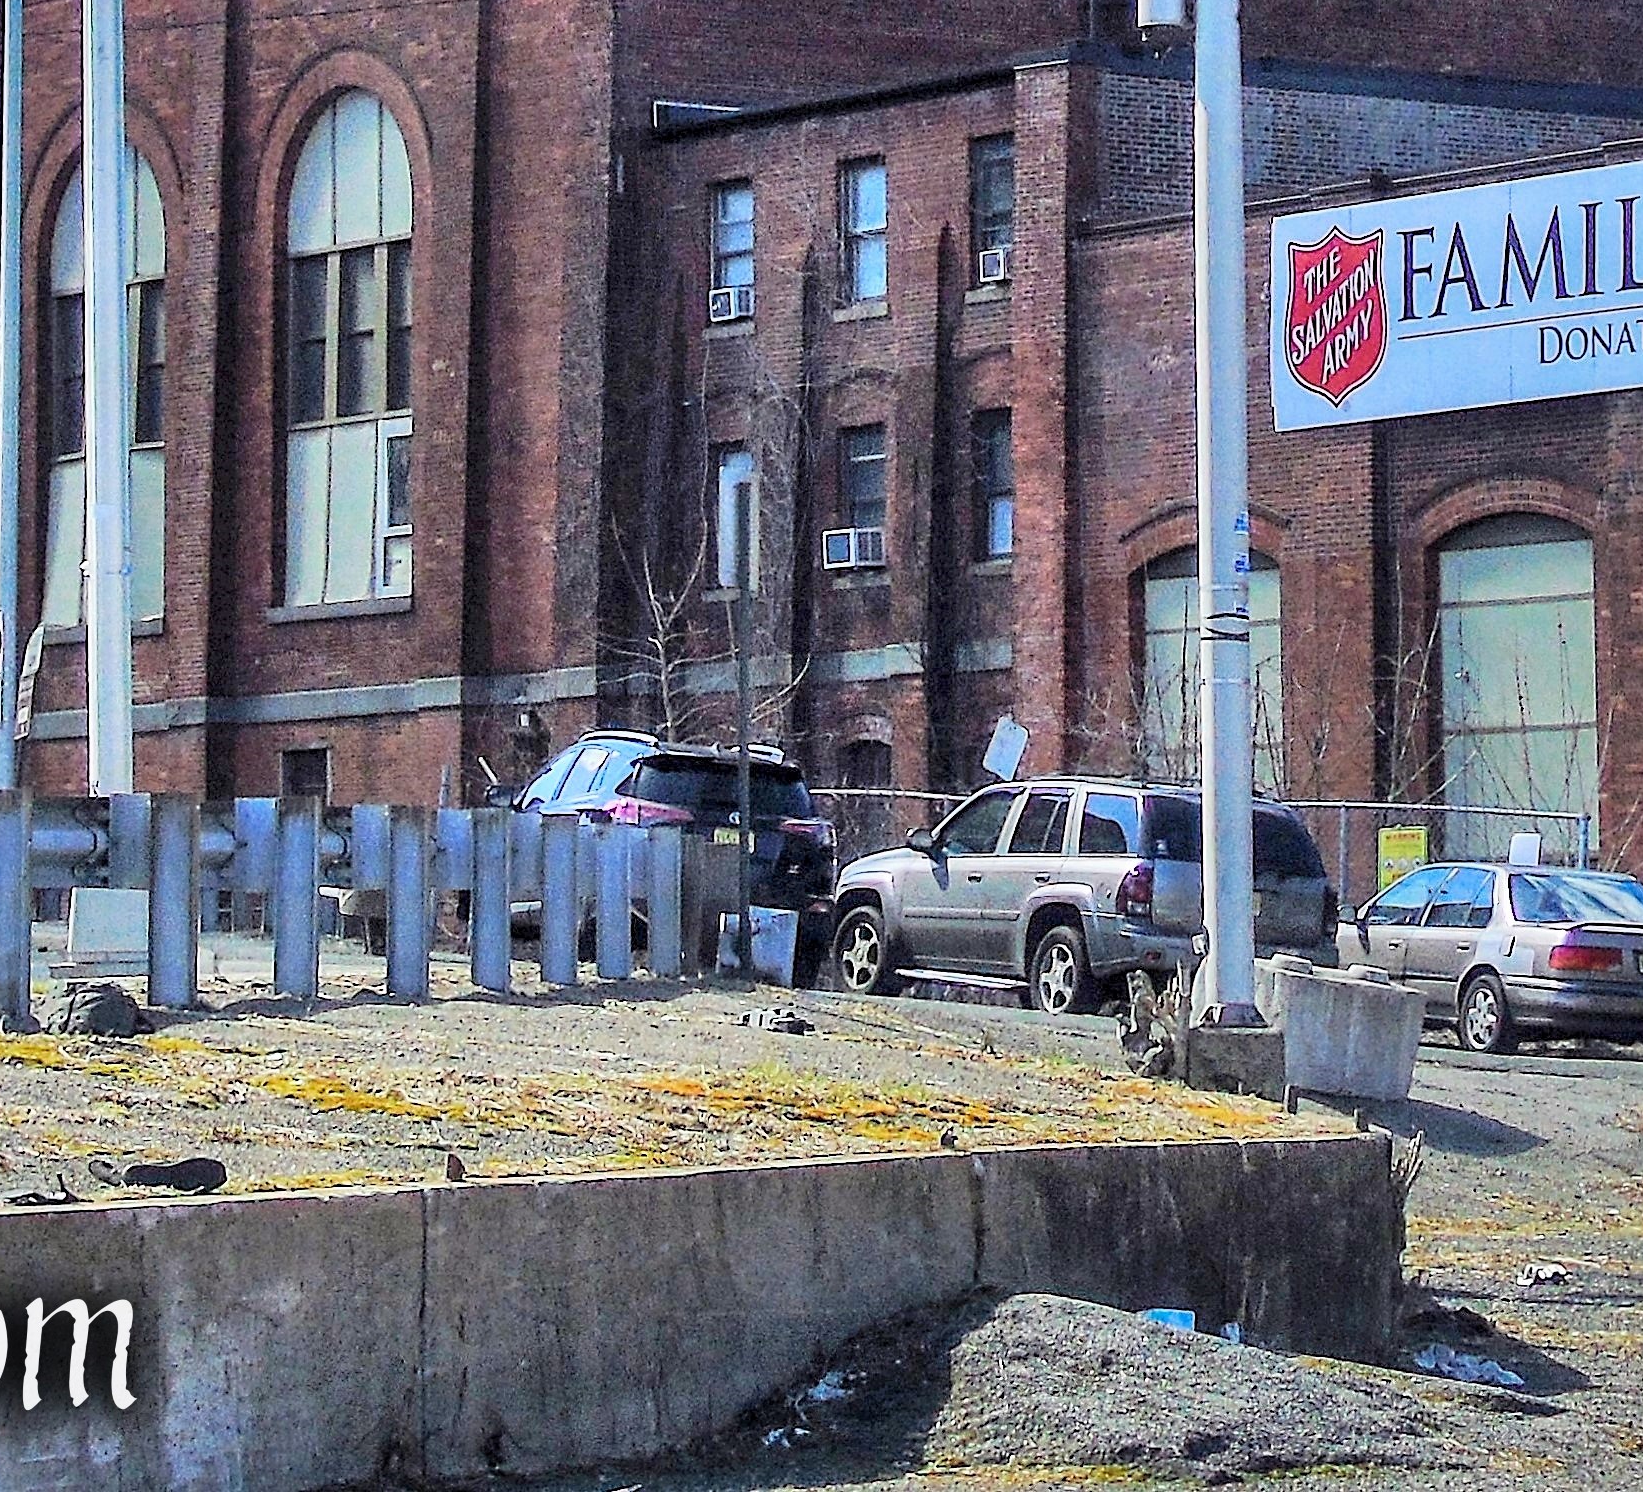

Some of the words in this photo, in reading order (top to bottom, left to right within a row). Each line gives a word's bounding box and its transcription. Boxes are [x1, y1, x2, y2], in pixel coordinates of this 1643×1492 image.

[1291, 248, 1375, 365] SALVATION
[1303, 245, 1342, 304] THE
[1321, 298, 1373, 385] ARMY
